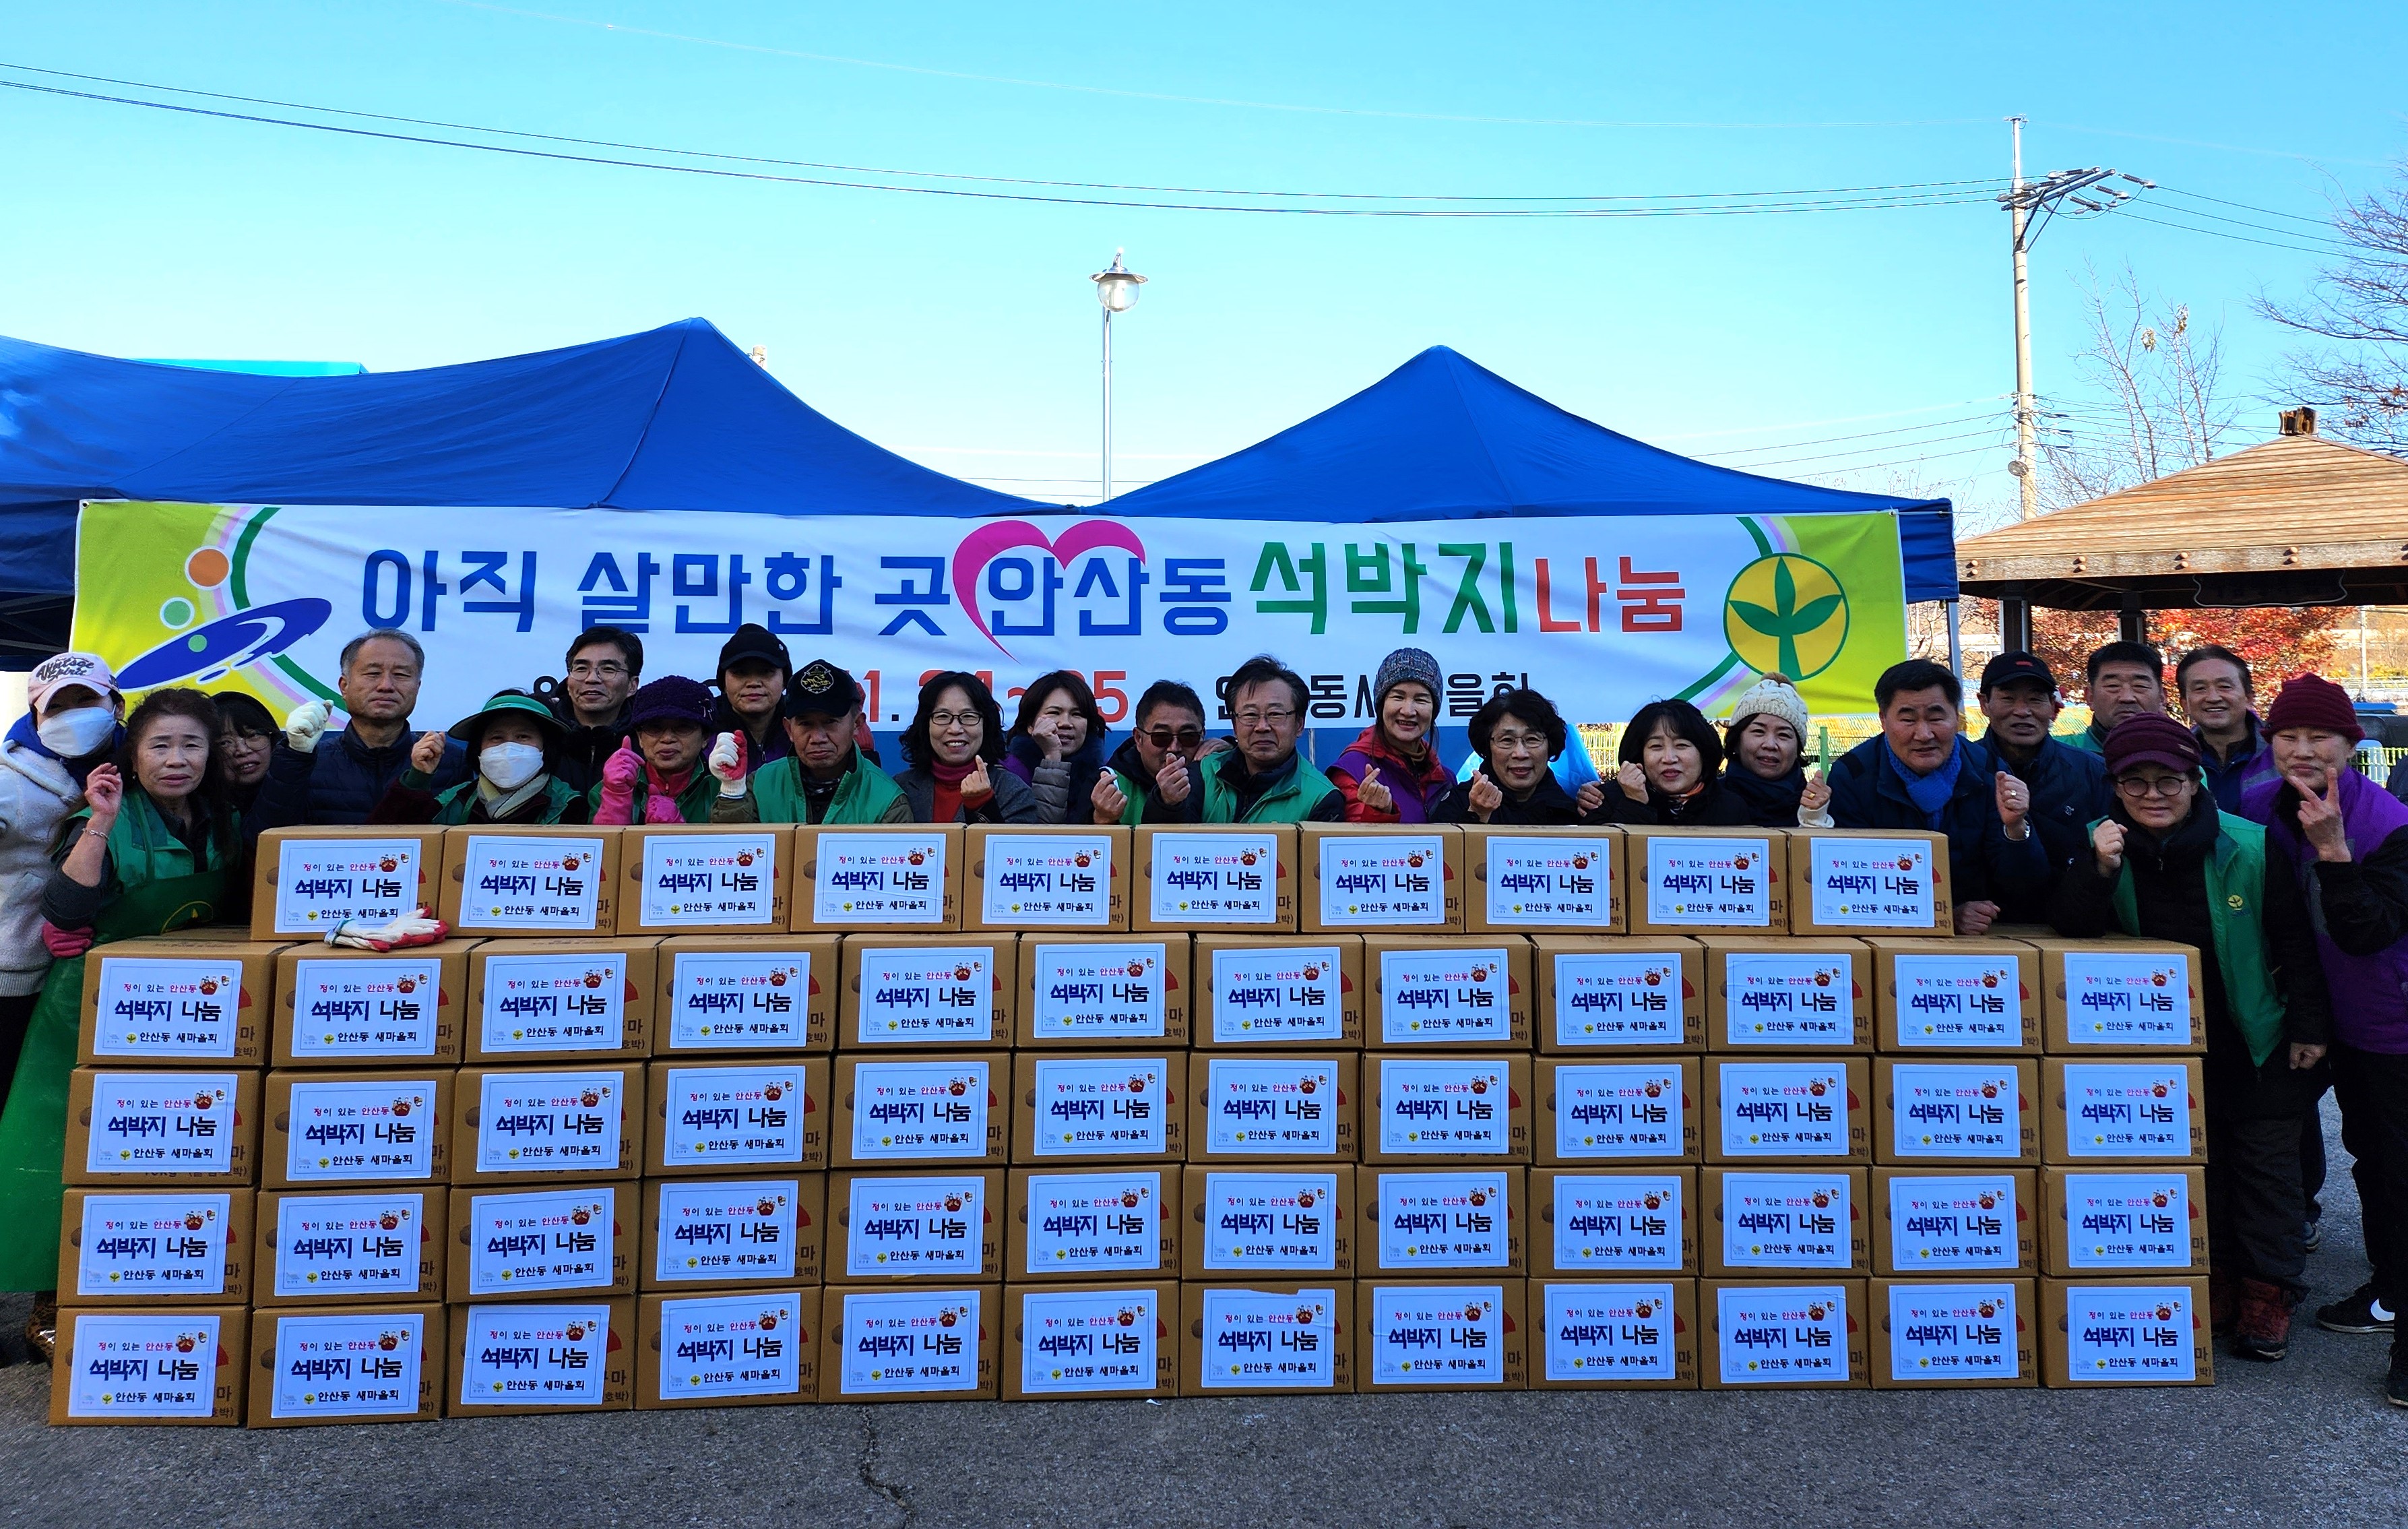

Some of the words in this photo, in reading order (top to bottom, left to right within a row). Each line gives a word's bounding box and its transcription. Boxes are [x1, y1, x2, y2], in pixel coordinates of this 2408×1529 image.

[362, 549, 537, 634] 아직
[577, 551, 843, 635] 살만한
[875, 557, 951, 636] 곳
[489, 859, 507, 869] 정이
[511, 860, 529, 869] 있는
[534, 861, 560, 869] 안산동
[1006, 857, 1022, 867] 정이
[1027, 858, 1044, 866] 있는
[1048, 858, 1072, 867] 안산동
[1341, 859, 1357, 868] 정이
[1361, 859, 1378, 868] 있는
[1382, 859, 1405, 867] 안산동
[1832, 860, 1847, 869] 정이
[1852, 861, 1868, 869] 있는
[1872, 861, 1895, 870] 안산동
[480, 875, 536, 896] 석박지
[545, 876, 584, 896] 나눔
[999, 873, 1051, 893] 석박지
[1060, 873, 1096, 893] 나눔
[1335, 873, 1386, 894] 석박지
[1395, 873, 1430, 893] 나눔
[1827, 875, 1876, 895] 석박지
[1884, 876, 1920, 896] 나눔
[504, 905, 535, 916] 안산동
[540, 906, 579, 916] 새마을회
[1023, 902, 1052, 912] 안산동
[1056, 902, 1094, 912] 새마을회
[1360, 902, 1388, 912] 안산동
[1392, 902, 1428, 912] 새마을회
[1851, 904, 1879, 914] 안산동
[1883, 904, 1919, 915] 새마을회
[696, 977, 714, 986] 정이
[718, 977, 736, 986] 있는
[741, 976, 767, 985] 안산동
[1234, 972, 1250, 982] 정이
[1255, 972, 1272, 981] 있는
[1276, 971, 1302, 980] 안산동
[1747, 976, 1763, 985] 정이
[1767, 976, 1784, 985] 있는
[1788, 977, 1813, 985] 안산동
[123, 983, 141, 993] 정이
[146, 984, 165, 993] 있는
[170, 985, 197, 994] 안산동
[688, 993, 744, 1014] 석박지
[753, 992, 792, 1013] 나눔
[1228, 987, 1281, 1009] 석박지
[1290, 987, 1326, 1007] 나눔
[1741, 991, 1793, 1012] 석박지
[1801, 992, 1837, 1012] 나눔
[114, 999, 172, 1022] 석박지
[181, 1001, 222, 1022] 나눔
[1254, 1018, 1283, 1028] 안산동
[1287, 1016, 1325, 1027] 새마을회
[1767, 1022, 1795, 1032] 안산동
[1799, 1022, 1836, 1032] 새마을회
[714, 1024, 744, 1034] 안산동
[749, 1023, 789, 1034] 새마을회
[139, 1032, 171, 1042] 안산동
[176, 1032, 218, 1044] 새마을회
[1057, 1084, 1074, 1093] 정이
[1079, 1084, 1096, 1093] 있는
[1100, 1083, 1127, 1092] 안산동
[1742, 1087, 1758, 1096] 정이
[1762, 1087, 1779, 1096] 있는
[1783, 1086, 1808, 1096] 안산동
[690, 1093, 707, 1102] 정이
[713, 1092, 730, 1102] 있는
[735, 1091, 762, 1100] 안산동
[117, 1099, 135, 1109] 정이
[140, 1099, 159, 1109] 있는
[164, 1099, 192, 1109] 안산동
[1050, 1099, 1104, 1121] 석박지
[1113, 1098, 1151, 1120] 나눔
[1736, 1102, 1788, 1123] 석박지
[1796, 1102, 1833, 1123] 나눔
[682, 1108, 739, 1131] 석박지
[748, 1107, 788, 1129] 나눔
[107, 1116, 166, 1137] 석박지
[176, 1116, 218, 1137] 나눔
[1076, 1130, 1106, 1141] 안산동
[1110, 1129, 1149, 1141] 새마을회
[1761, 1132, 1790, 1142] 안산동
[1794, 1132, 1832, 1143] 새마을회
[708, 1140, 739, 1151] 안산동
[744, 1138, 784, 1150] 새마을회
[133, 1148, 166, 1159] 안산동
[170, 1148, 213, 1159] 새마을회
[872, 1203, 889, 1212] 정이
[894, 1202, 912, 1212] 있는
[916, 1202, 942, 1211] 안산동
[1400, 1197, 1416, 1207] 정이
[1421, 1197, 1438, 1206] 있는
[1443, 1197, 1467, 1206] 안산동
[1911, 1201, 1928, 1210] 정이
[1932, 1201, 1949, 1210] 있는
[1953, 1200, 1977, 1209] 안산동
[301, 1222, 319, 1231] 정이
[325, 1221, 344, 1230] 있는
[349, 1220, 377, 1230] 안산동
[864, 1218, 920, 1241] 석박지
[928, 1218, 968, 1240] 나눔
[1393, 1213, 1447, 1235] 석박지
[1455, 1212, 1493, 1234] 나눔
[1906, 1216, 1959, 1237] 석박지
[1966, 1215, 2002, 1236] 나눔
[293, 1237, 353, 1260] 석박지
[362, 1236, 404, 1258] 나눔
[1420, 1244, 1449, 1255] 안산동
[1453, 1243, 1491, 1254] 새마을회
[1932, 1246, 1961, 1257] 안산동
[1965, 1245, 2002, 1256] 새마을회
[890, 1250, 920, 1261] 안산동
[924, 1249, 964, 1261] 새마을회
[321, 1270, 353, 1281] 안산동
[358, 1268, 400, 1280] 새마을회
[1395, 1312, 1411, 1321] 정이
[1416, 1311, 1433, 1321] 있는
[1437, 1311, 1463, 1321] 안산동
[1911, 1309, 1927, 1318] 정이
[1932, 1309, 1948, 1318] 있는
[1952, 1309, 1977, 1317] 안산동
[684, 1324, 701, 1334] 정이
[707, 1323, 725, 1333] 있는
[730, 1321, 757, 1332] 안산동
[1388, 1328, 1441, 1350] 석박지
[1451, 1328, 1488, 1349] 나눔
[1905, 1325, 1957, 1346] 석박지
[1965, 1324, 2002, 1345] 나눔
[98, 1342, 117, 1352] 정이
[121, 1342, 140, 1352] 있는
[146, 1342, 173, 1352] 안산동
[676, 1339, 734, 1363] 석박지
[743, 1336, 783, 1360] 나눔
[1414, 1359, 1443, 1370] 안산동
[1448, 1359, 1486, 1370] 새마을회
[1931, 1355, 1960, 1366] 안산동
[1964, 1354, 2002, 1366] 새마을회
[89, 1359, 148, 1381] 석박지
[158, 1359, 199, 1381] 나눔
[703, 1371, 735, 1383] 안산동
[740, 1369, 780, 1381] 새마을회
[115, 1392, 148, 1403] 안산동
[152, 1392, 195, 1403] 새마을회
